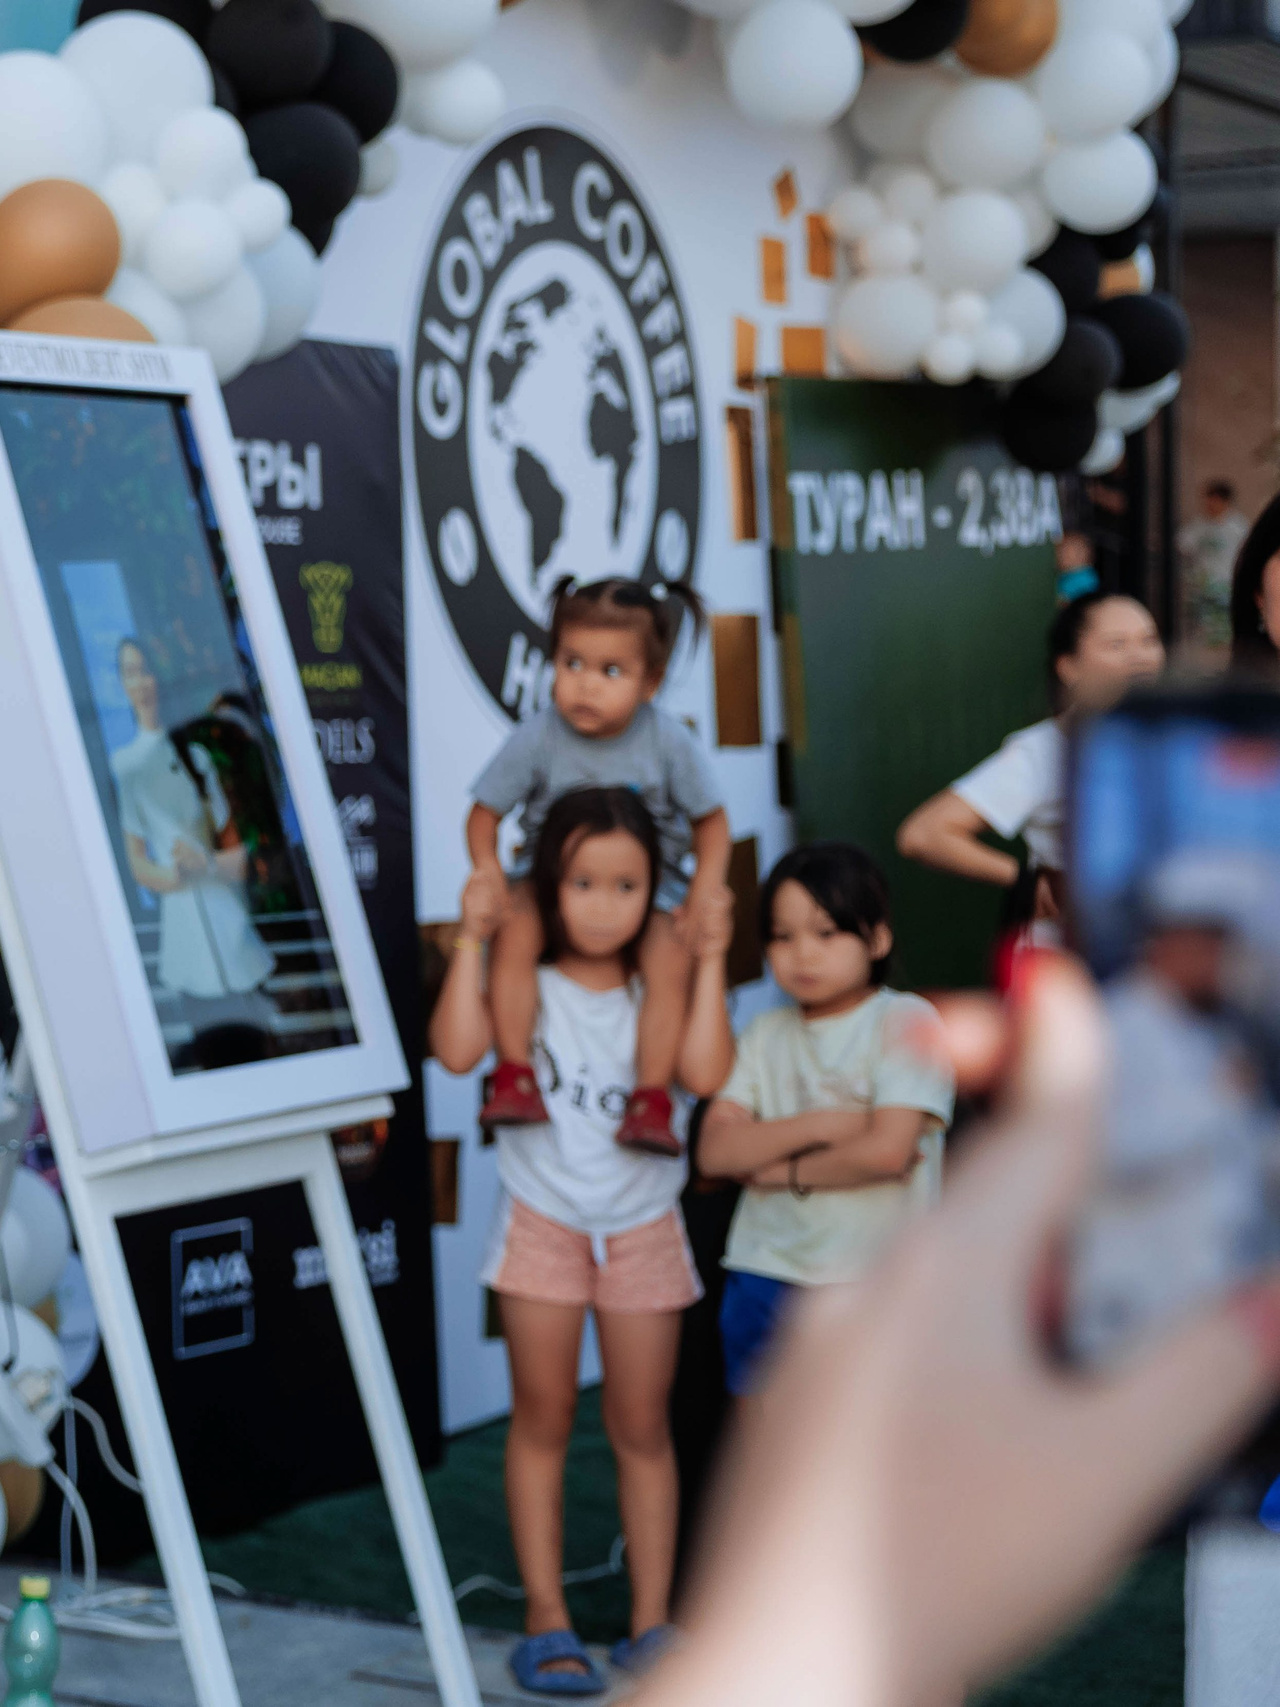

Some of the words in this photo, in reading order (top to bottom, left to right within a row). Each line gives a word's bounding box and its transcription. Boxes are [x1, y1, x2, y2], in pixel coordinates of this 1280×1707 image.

[418, 147, 554, 441] GLOBAL
[571, 161, 698, 446] COFFEE
[787, 469, 927, 557] ТУРАН
